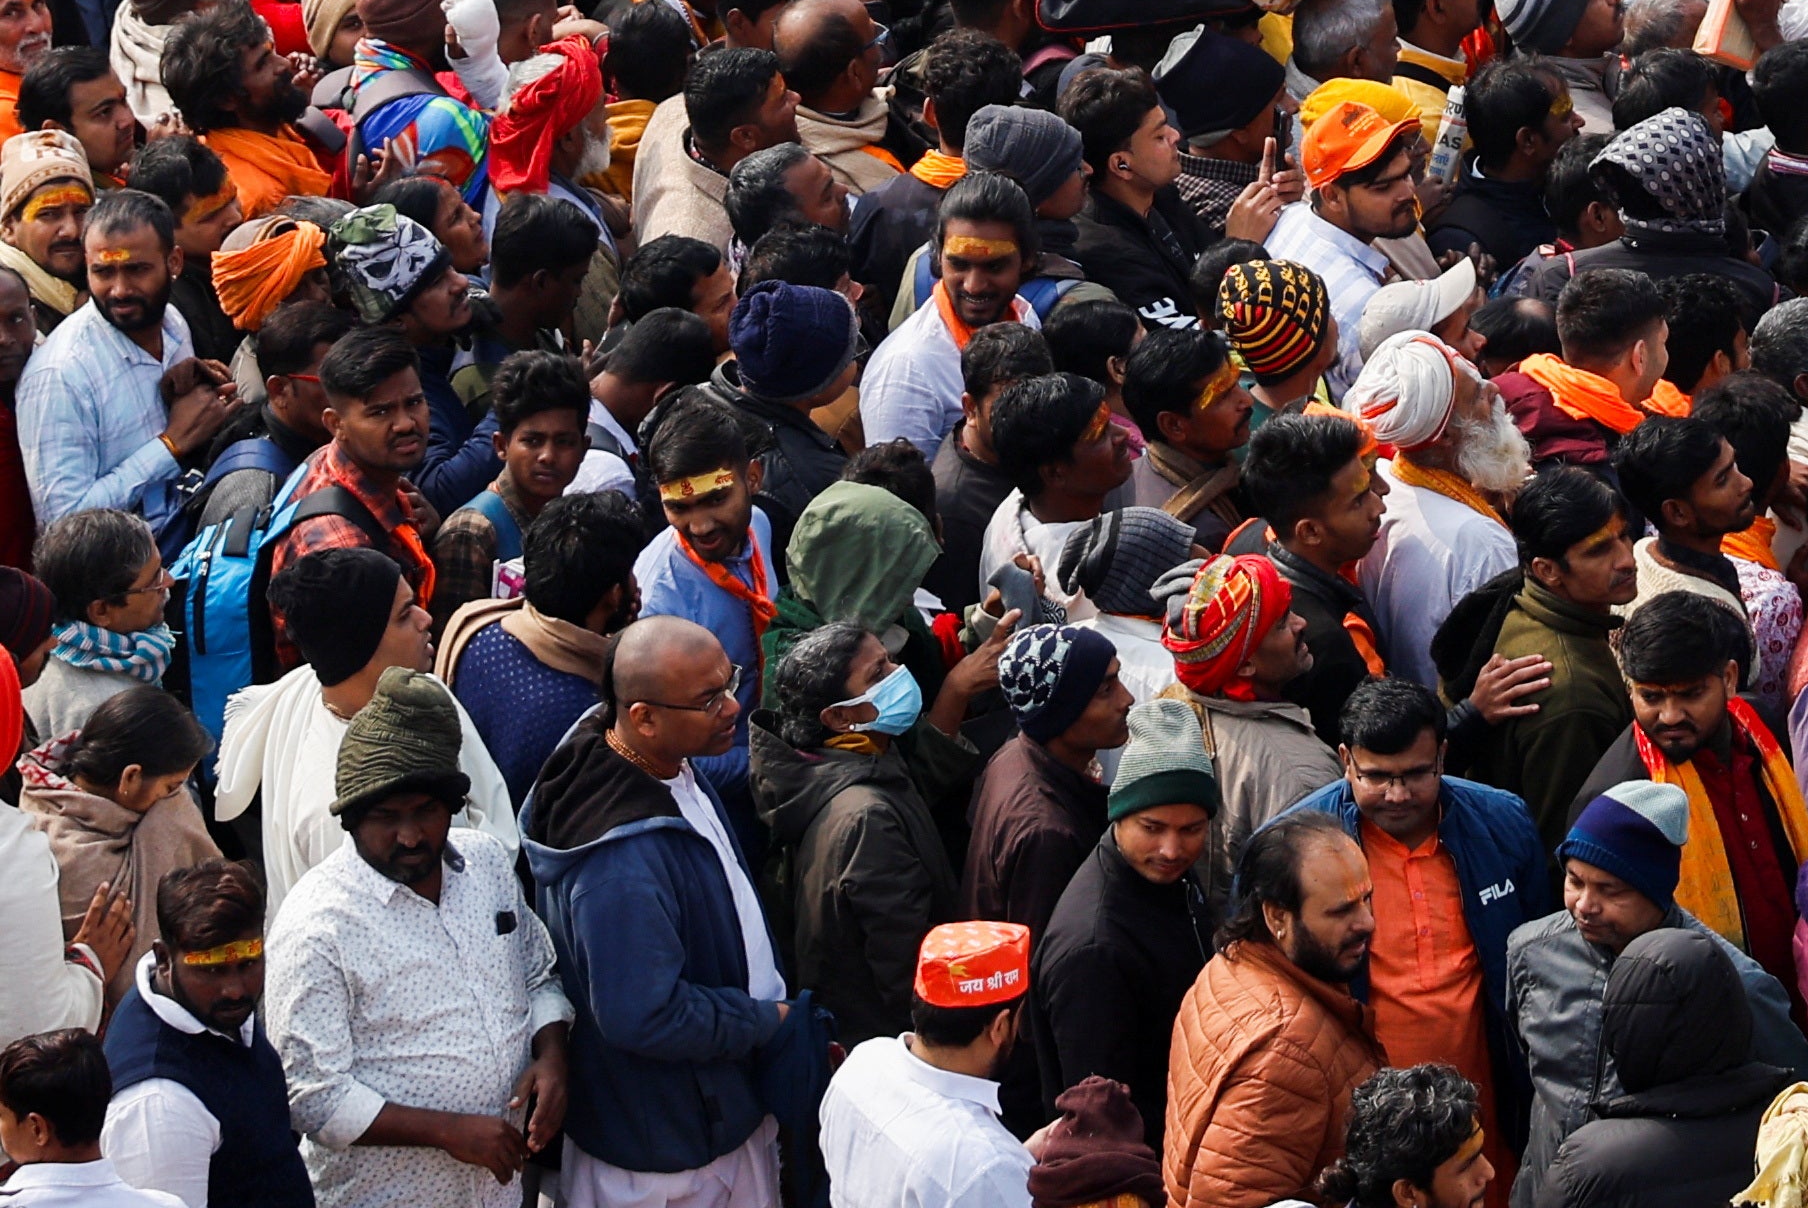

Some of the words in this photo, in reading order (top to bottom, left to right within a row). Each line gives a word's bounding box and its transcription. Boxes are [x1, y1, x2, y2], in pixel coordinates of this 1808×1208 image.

[1479, 879, 1515, 905] FILA
[959, 978, 984, 994] जय
[986, 971, 1003, 990] श्री
[1003, 969, 1020, 985] राम
